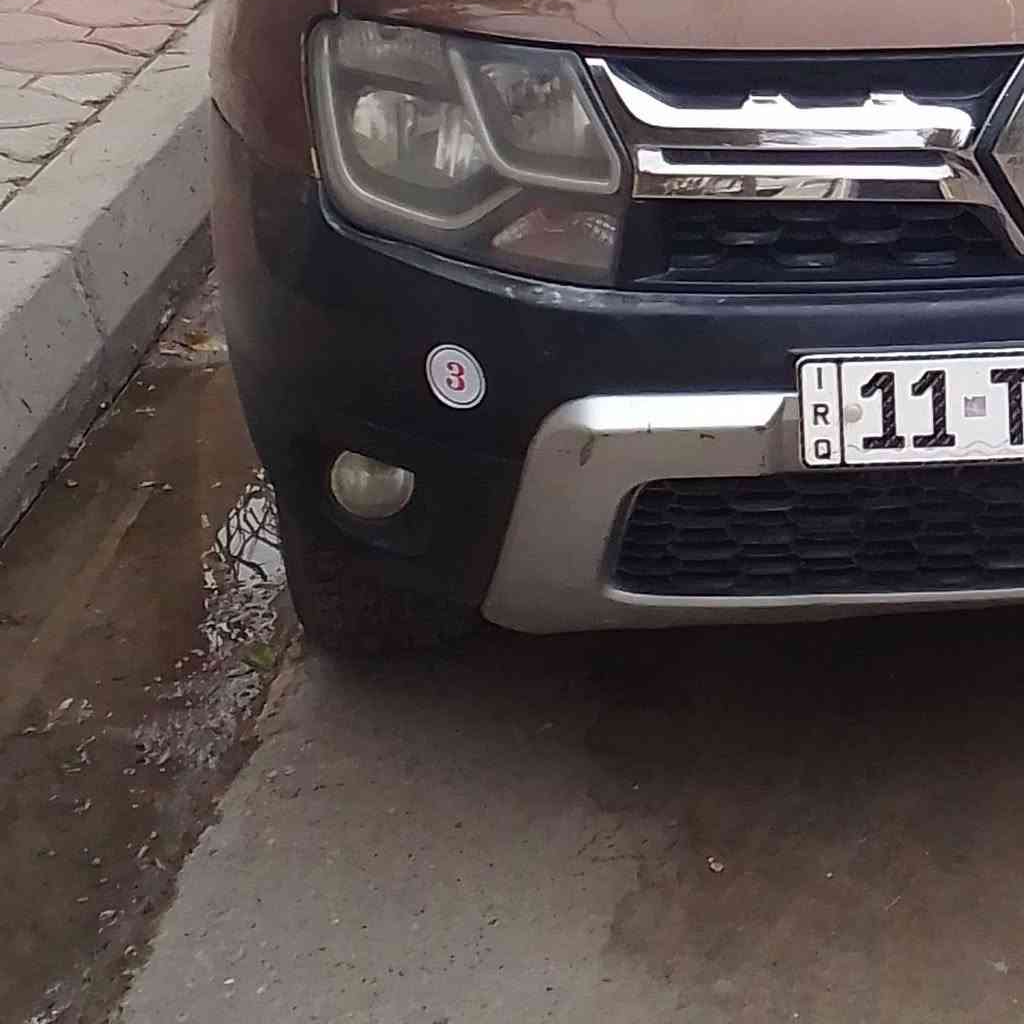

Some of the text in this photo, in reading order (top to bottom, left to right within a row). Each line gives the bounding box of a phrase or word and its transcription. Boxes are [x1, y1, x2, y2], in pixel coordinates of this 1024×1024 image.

[446, 361, 465, 391] 3
[812, 367, 832, 460] IRQ
[860, 370, 956, 449] 11
